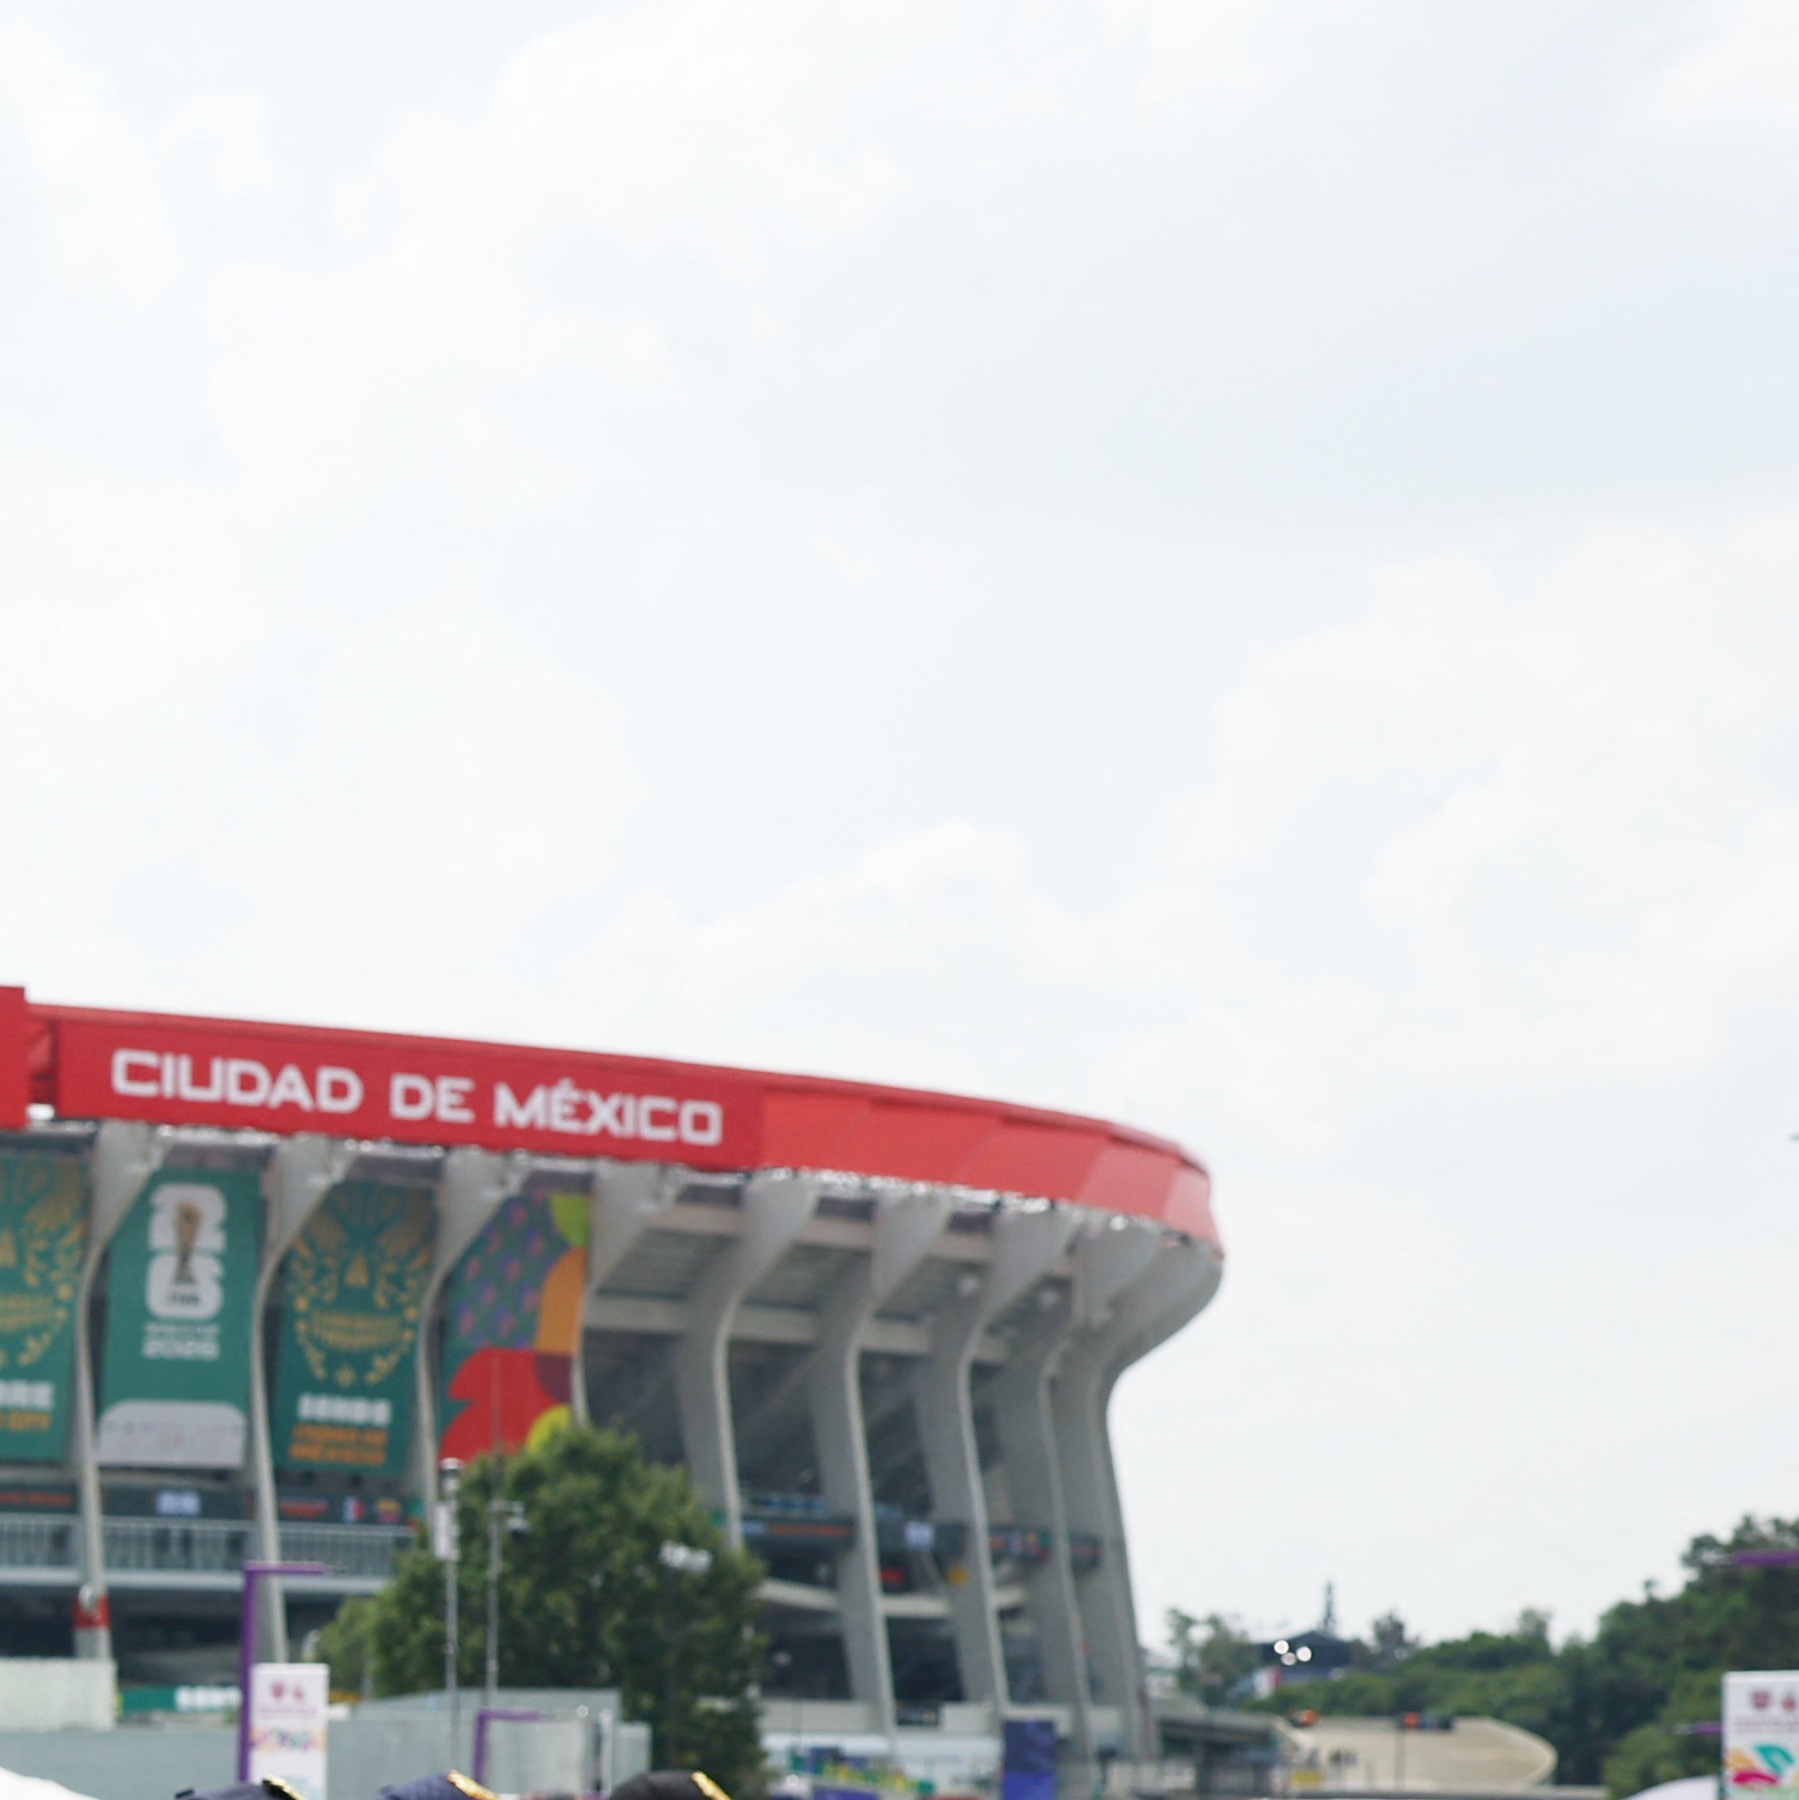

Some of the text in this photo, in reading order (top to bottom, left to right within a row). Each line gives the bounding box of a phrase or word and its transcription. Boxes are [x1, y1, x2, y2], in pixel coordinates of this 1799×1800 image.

[110, 1047, 724, 1147] CIUDAD DE MÉXICO
